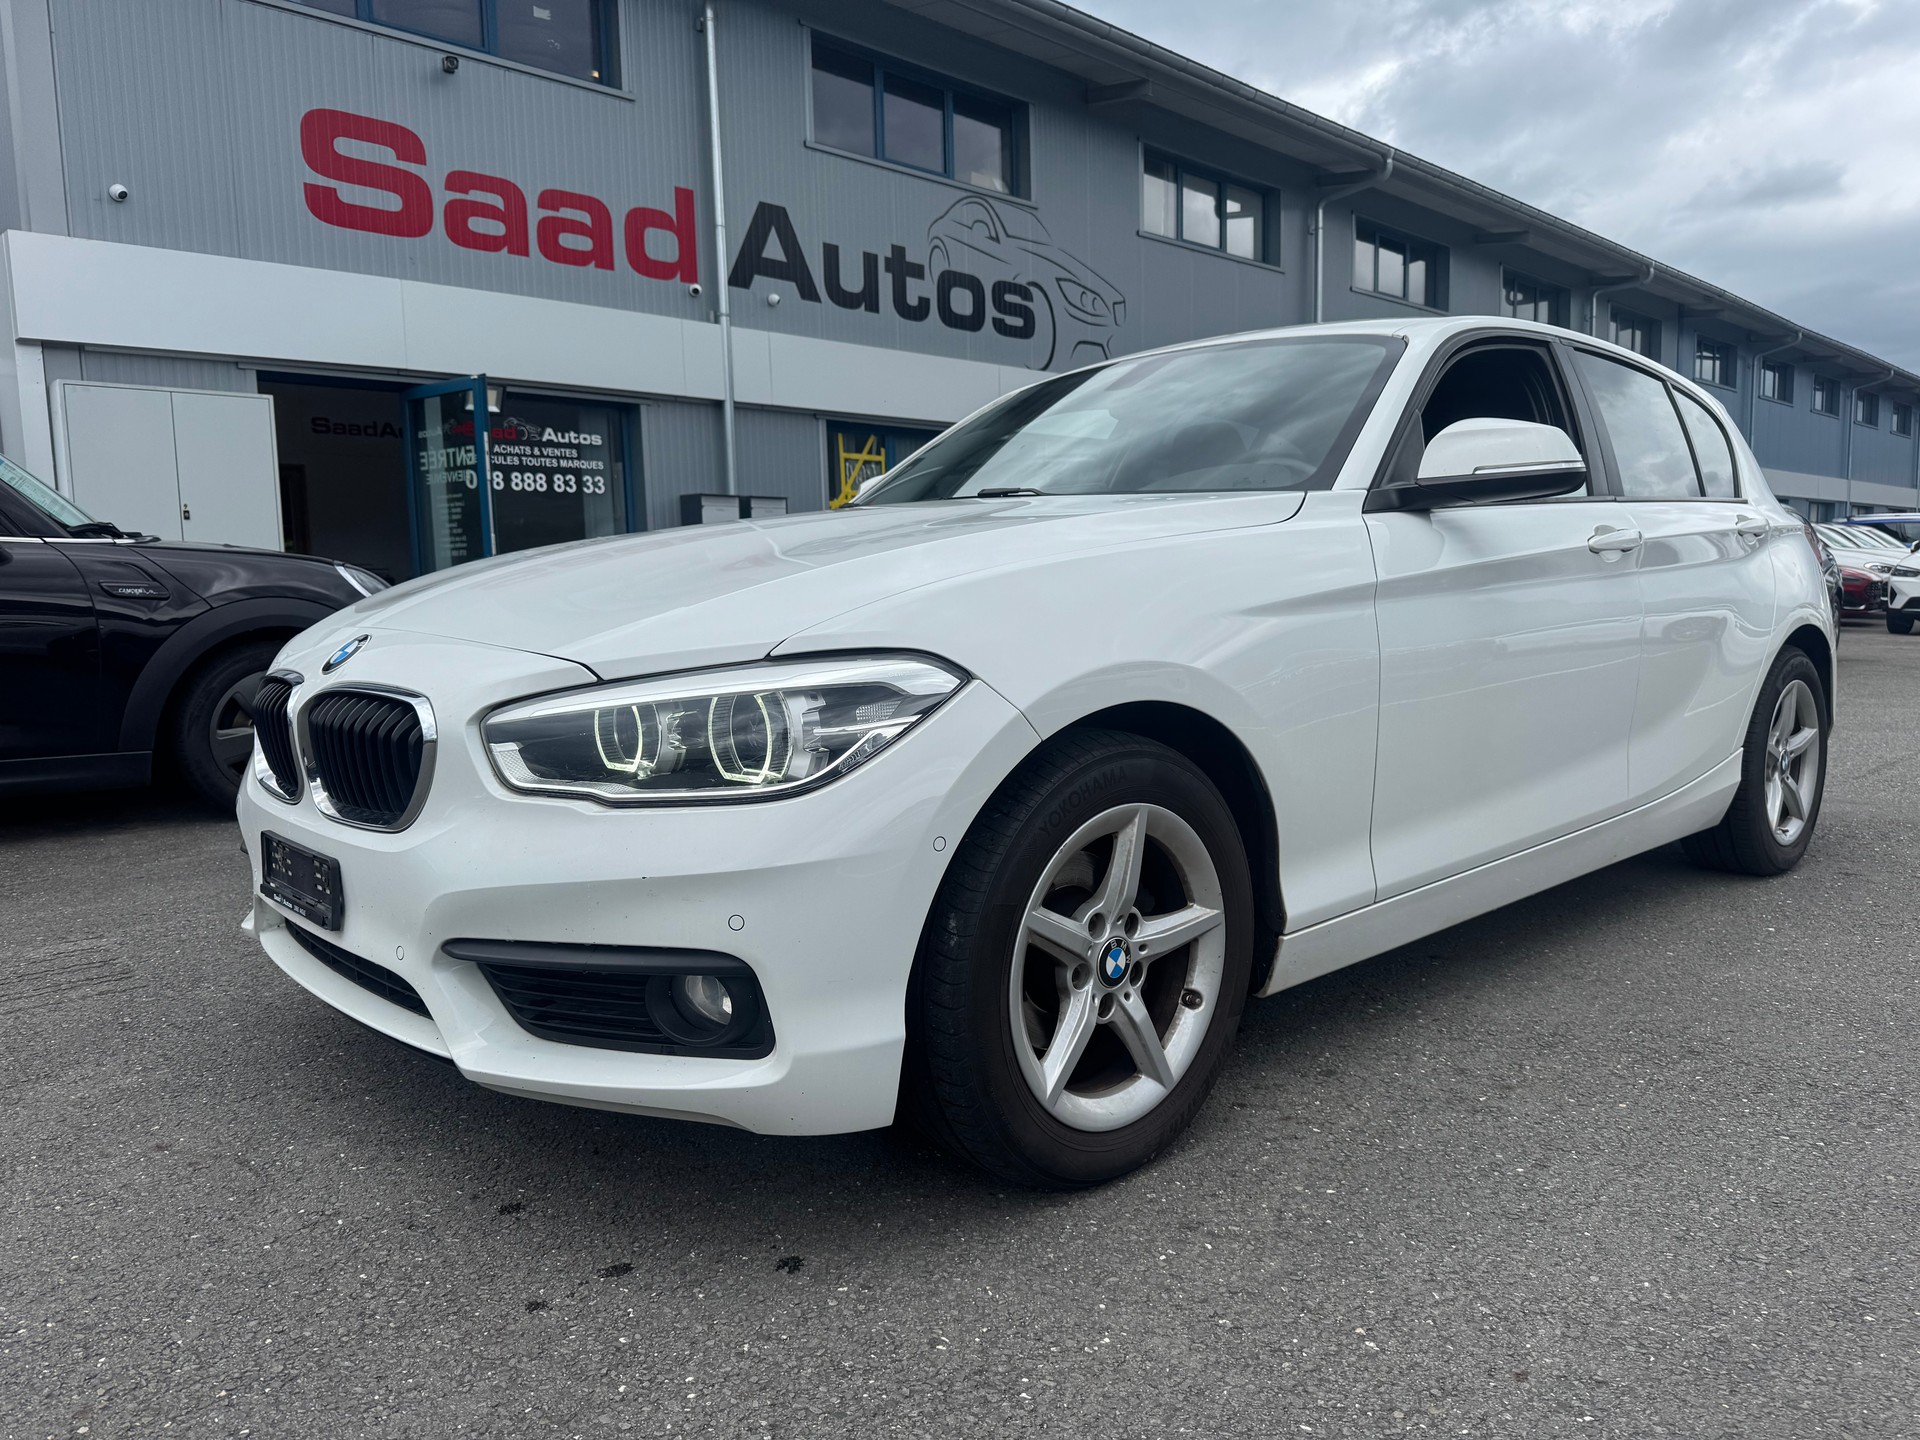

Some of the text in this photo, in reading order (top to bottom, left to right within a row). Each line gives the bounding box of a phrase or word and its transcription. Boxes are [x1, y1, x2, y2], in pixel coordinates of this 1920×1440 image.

[300, 108, 1036, 339] Saad Autos
[542, 427, 602, 445] Autos
[493, 445, 578, 458] ACHATS & VENTES
[522, 457, 558, 468] TOUTES
[560, 459, 604, 470] MARQUES
[510, 472, 547, 492] 888
[553, 474, 577, 493] 83
[583, 475, 605, 494] 33
[1039, 766, 1127, 836] YOKOHAMA
[1110, 939, 1131, 964] BMW
